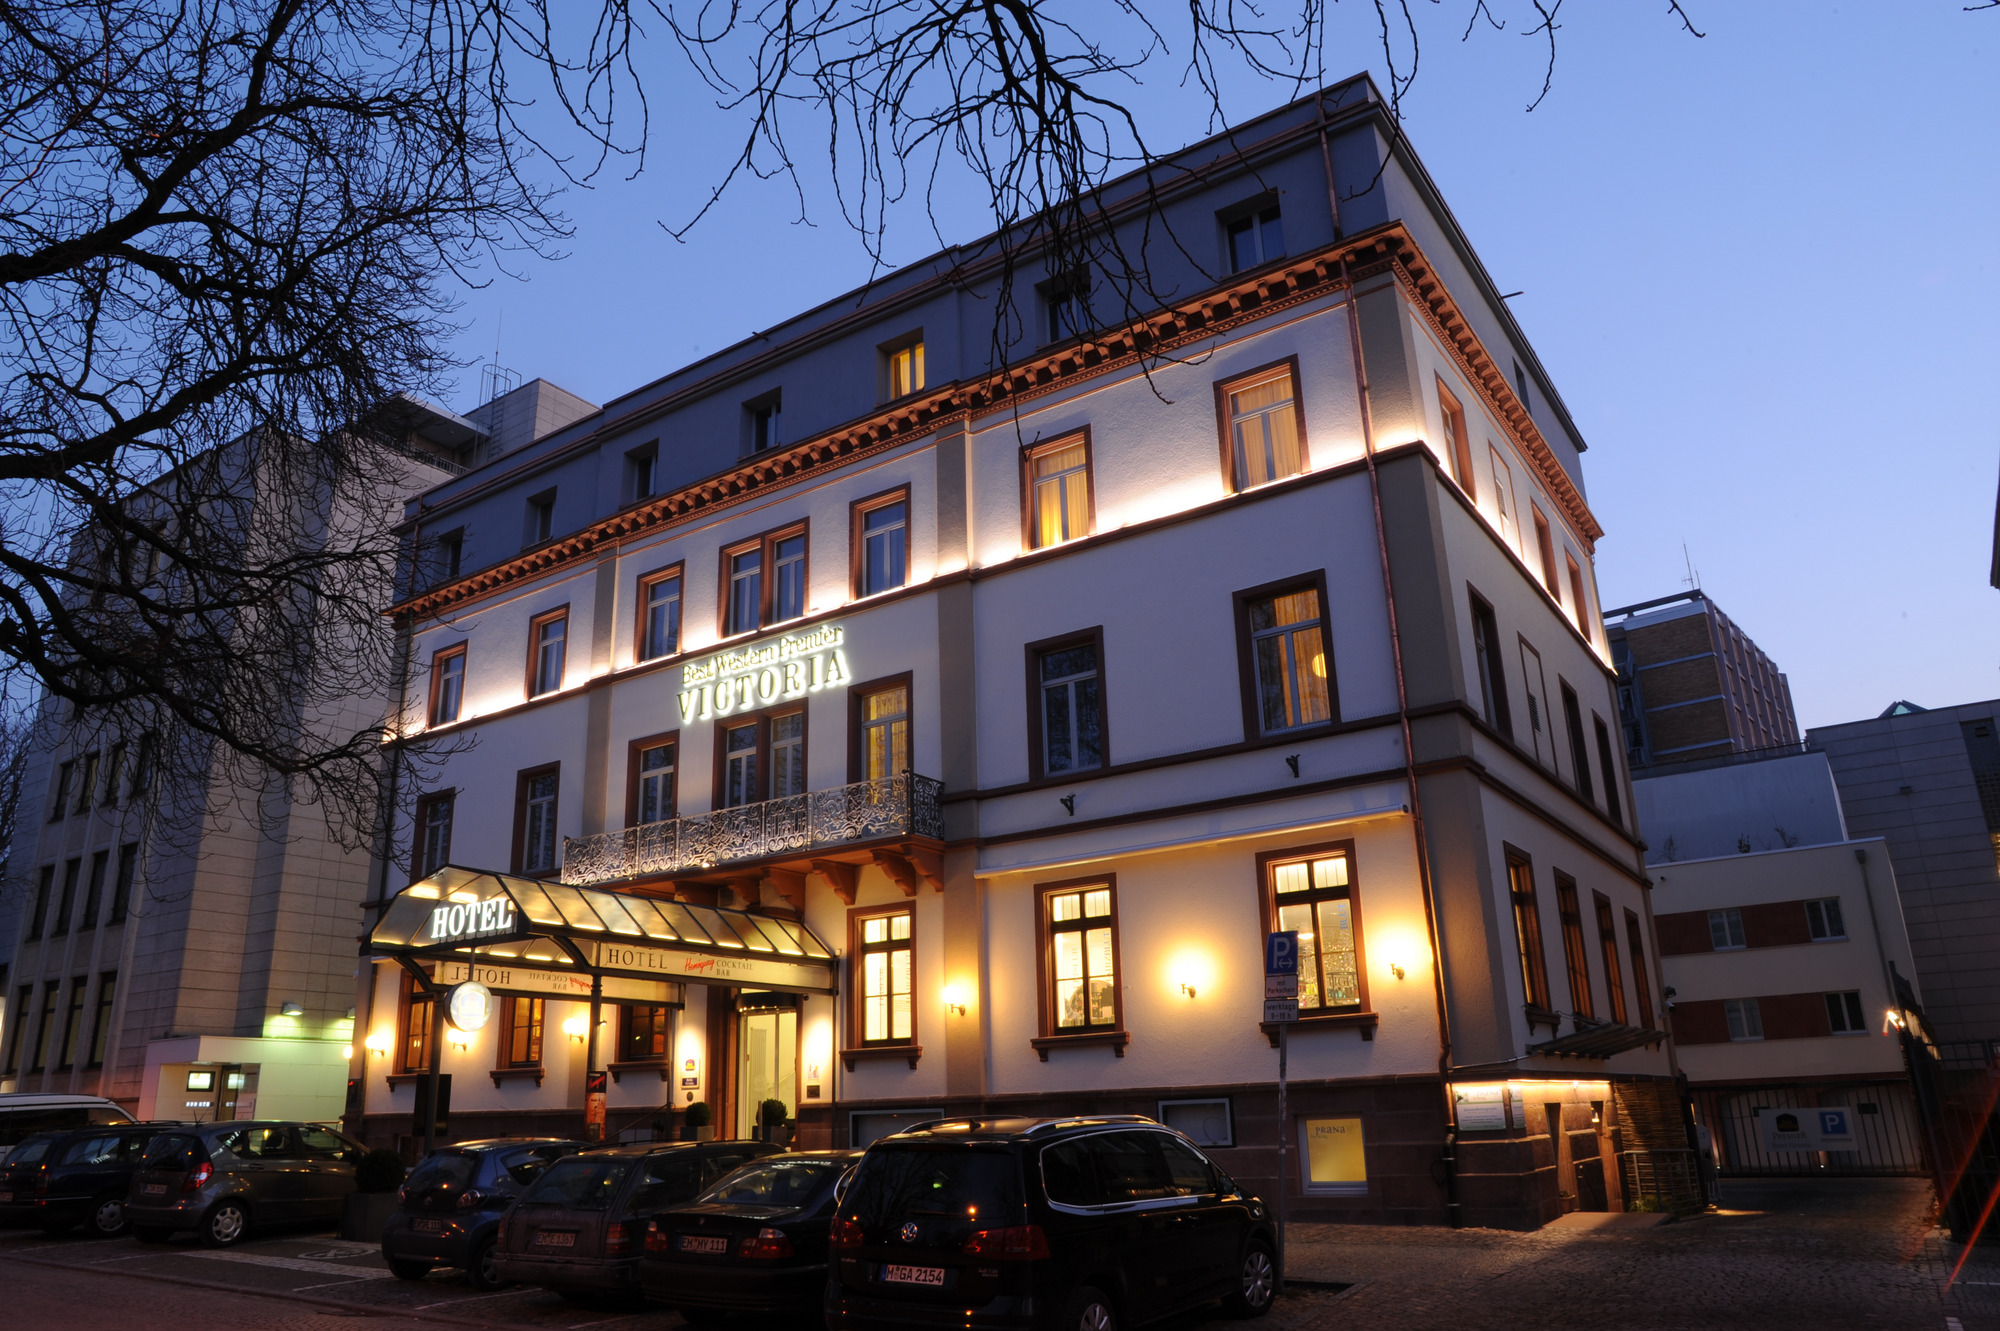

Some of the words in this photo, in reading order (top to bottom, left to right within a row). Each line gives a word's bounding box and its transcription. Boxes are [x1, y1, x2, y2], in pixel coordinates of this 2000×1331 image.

[682, 659, 715, 685] Best
[716, 646, 776, 675] Western
[779, 626, 843, 659] Premier
[677, 650, 851, 723] VICTORIA
[431, 898, 512, 939] HOTEL
[609, 948, 667, 969] HOTEL
[1273, 937, 1291, 969] P
[716, 959, 753, 971] COCKTAIL
[716, 969, 731, 977] BAR
[1267, 986, 1295, 994] Parkschein
[1266, 1003, 1296, 1012] werktags
[1825, 1114, 1840, 1132] P
[682, 1237, 693, 1249] EM
[710, 1240, 725, 1251] 111
[886, 1265, 895, 1280] M
[899, 1267, 914, 1281] GA
[914, 1268, 944, 1284] 2154
